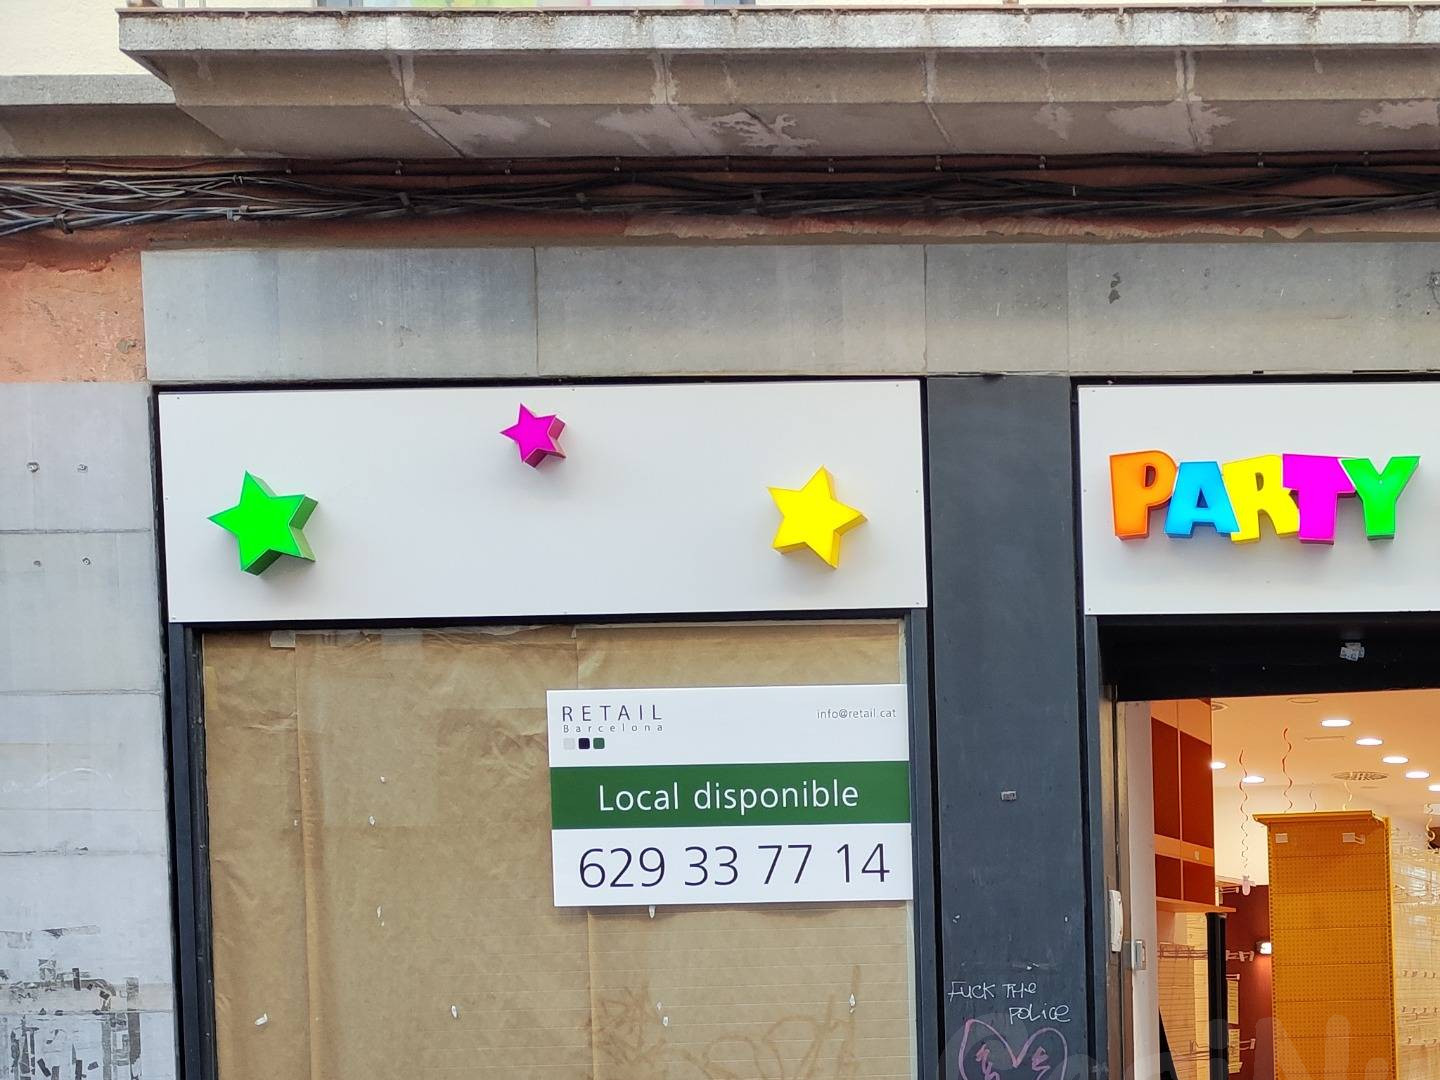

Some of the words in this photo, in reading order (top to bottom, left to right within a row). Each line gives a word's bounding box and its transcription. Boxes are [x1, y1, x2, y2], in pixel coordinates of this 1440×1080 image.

[1108, 449, 1421, 545] PARTY
[562, 705, 662, 721] RETAIL
[563, 723, 664, 733] Barcelona
[599, 782, 679, 811] Local
[694, 779, 859, 815] disponible
[579, 847, 665, 888] 629
[684, 846, 739, 886] 33
[758, 844, 812, 884] 77
[836, 843, 890, 883] 14
[948, 981, 995, 1002] FUCK
